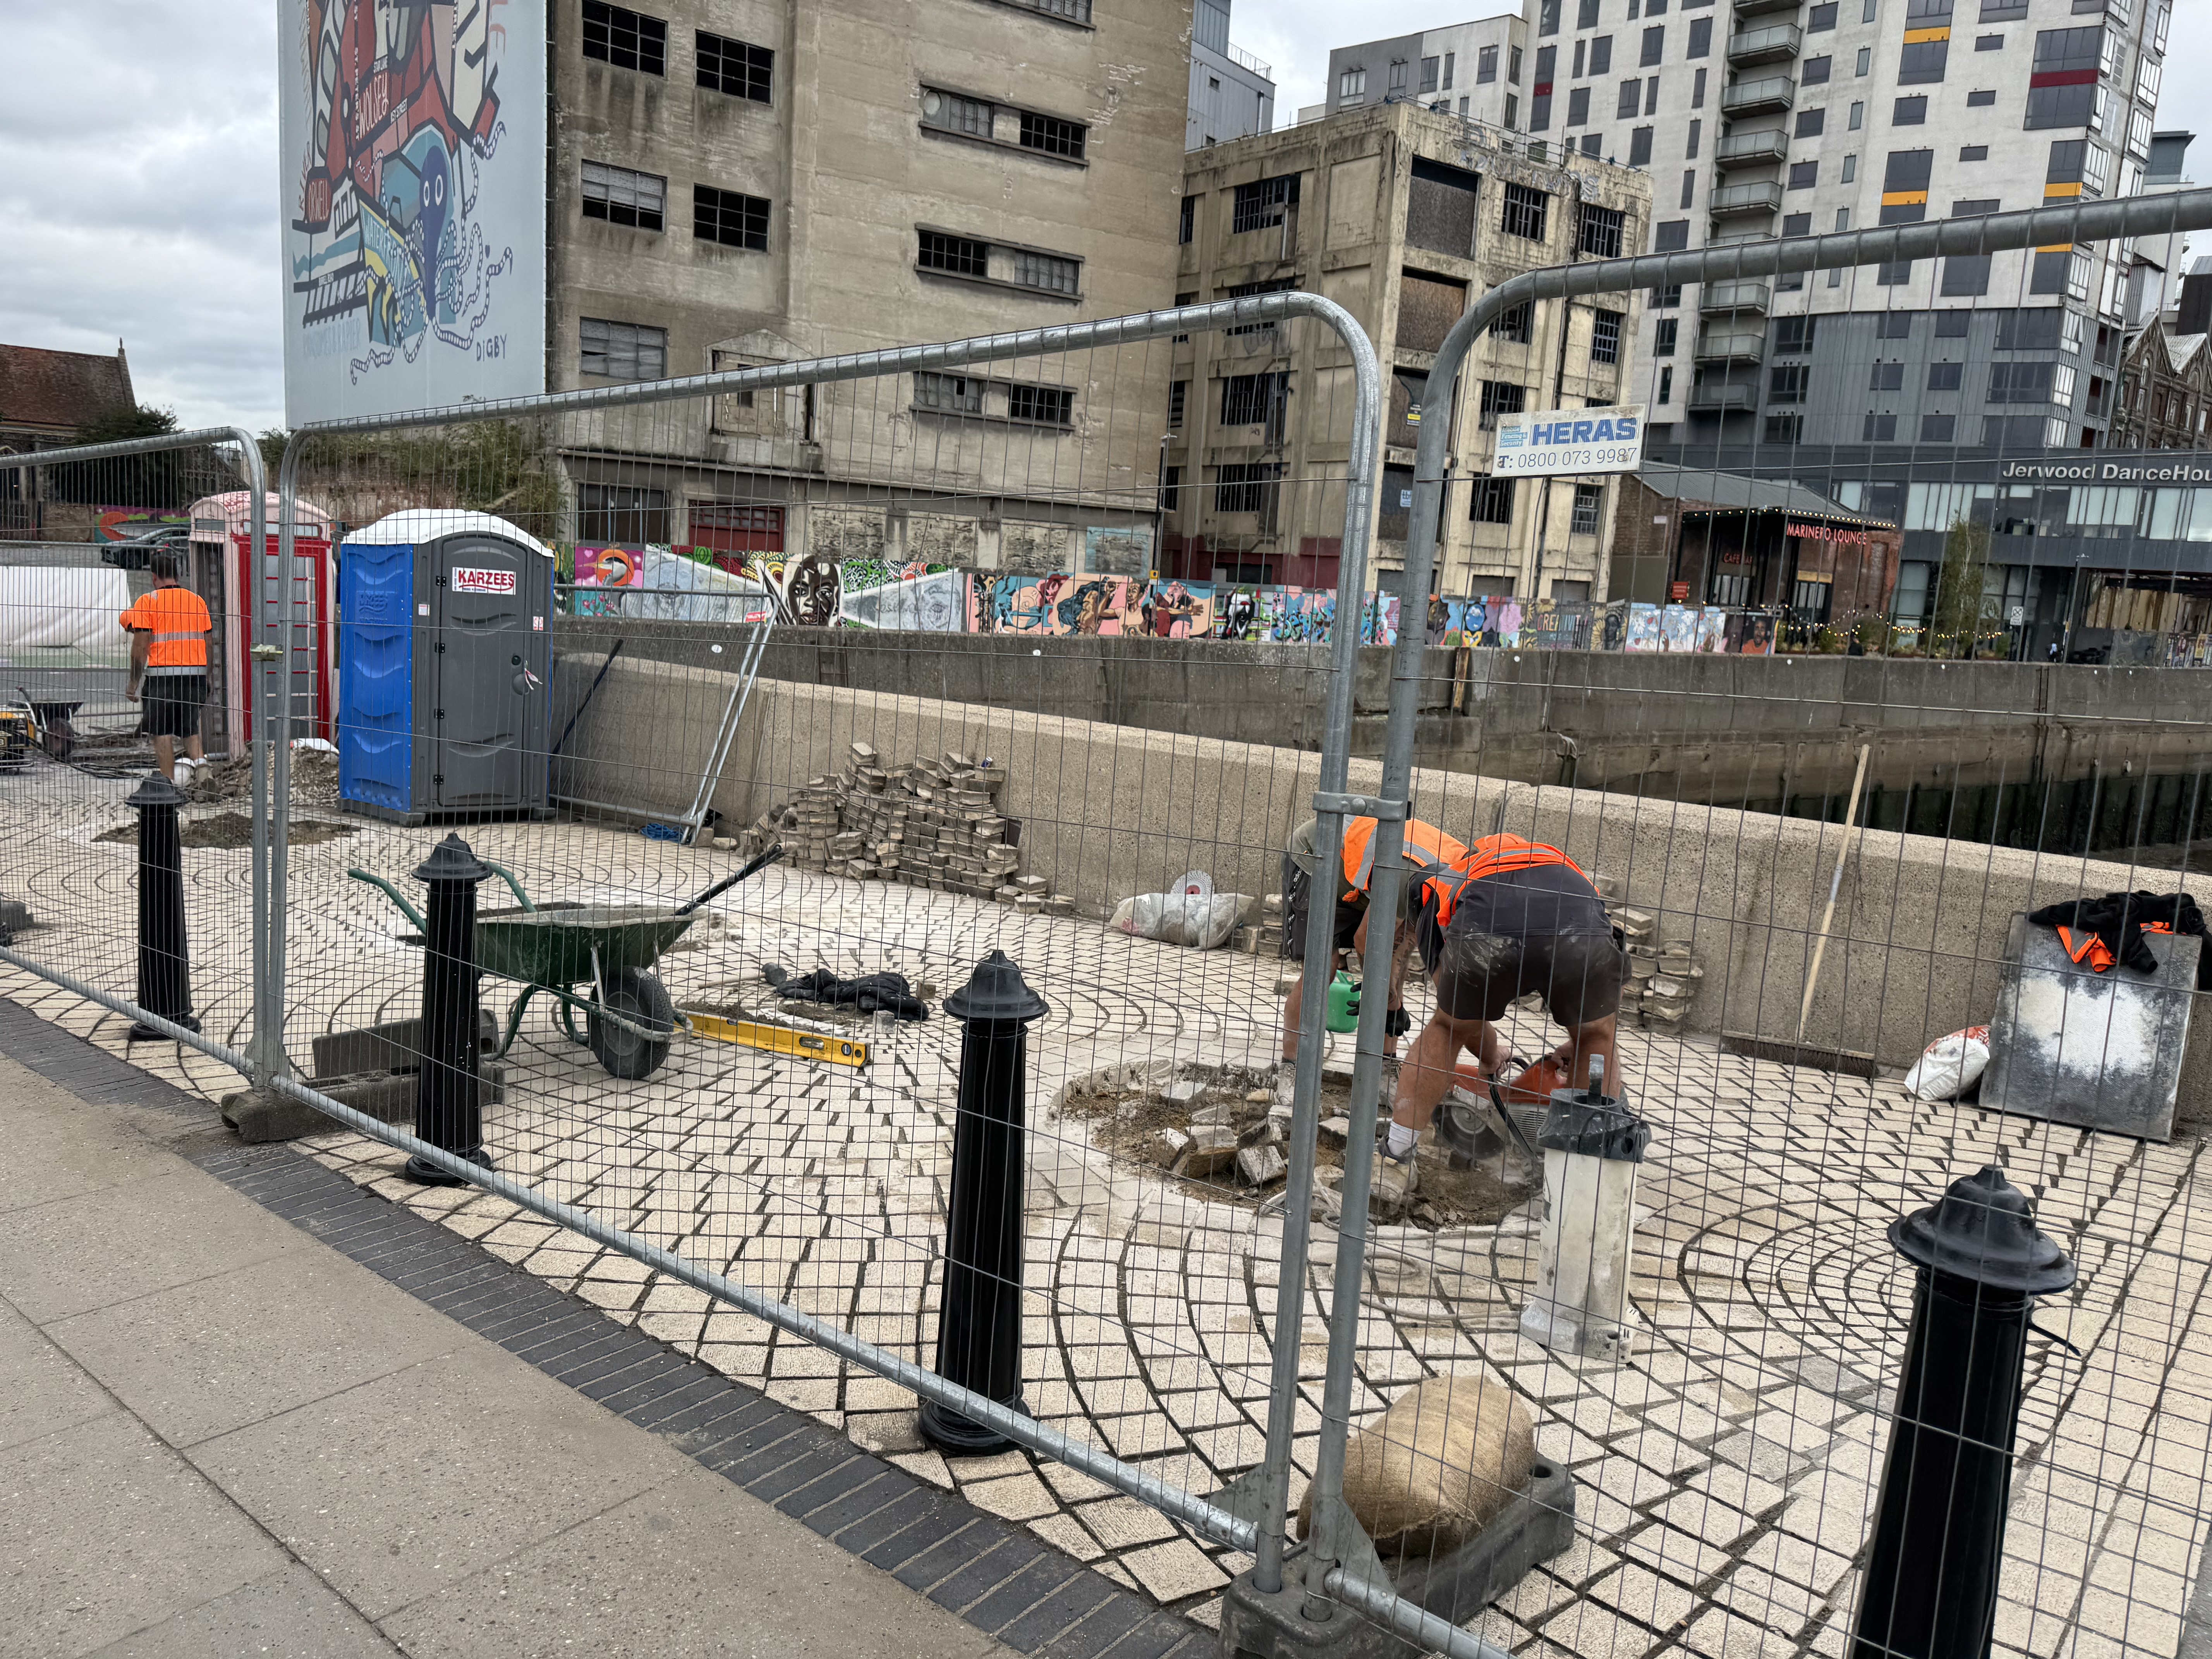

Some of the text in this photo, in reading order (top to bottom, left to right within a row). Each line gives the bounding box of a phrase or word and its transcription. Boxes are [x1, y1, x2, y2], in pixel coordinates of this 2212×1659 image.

[1532, 417, 1637, 446] HERAS
[1498, 448, 1637, 469] T: 0800 073 9987
[2002, 462, 2096, 479] Jerwood
[1787, 522, 1867, 545] MARINERO LOUNGE
[458, 570, 514, 587] KARZEES
